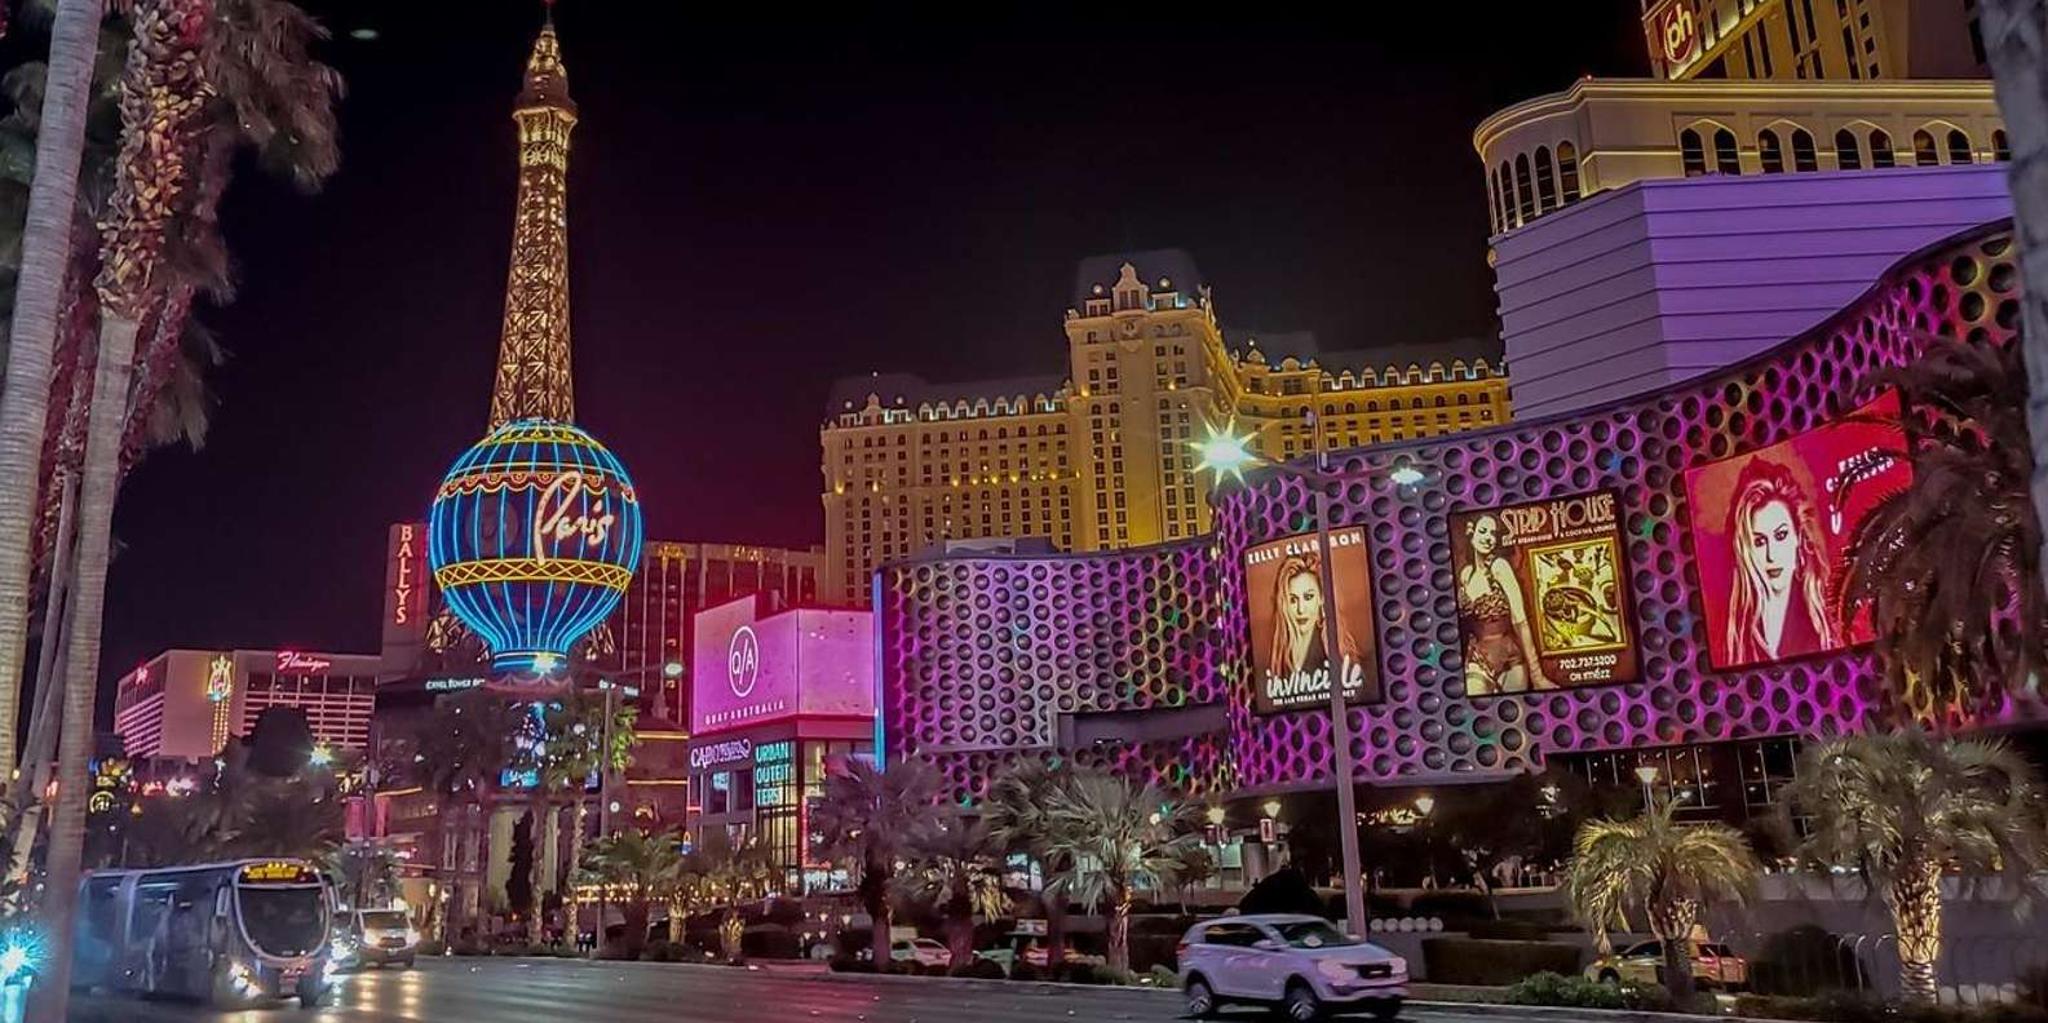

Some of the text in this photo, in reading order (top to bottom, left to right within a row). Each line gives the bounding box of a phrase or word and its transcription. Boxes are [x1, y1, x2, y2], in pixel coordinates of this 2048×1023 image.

[1666, 3, 1693, 57] ph
[534, 470, 615, 565] Paris
[1500, 493, 1615, 542] STRIP HOUSE
[1247, 531, 1362, 565] KELLY CLARSON
[277, 650, 331, 672] Flamingo
[1266, 653, 1363, 698] invincile
[730, 699, 785, 721] AUSTRALIA
[755, 741, 789, 763] URBAN
